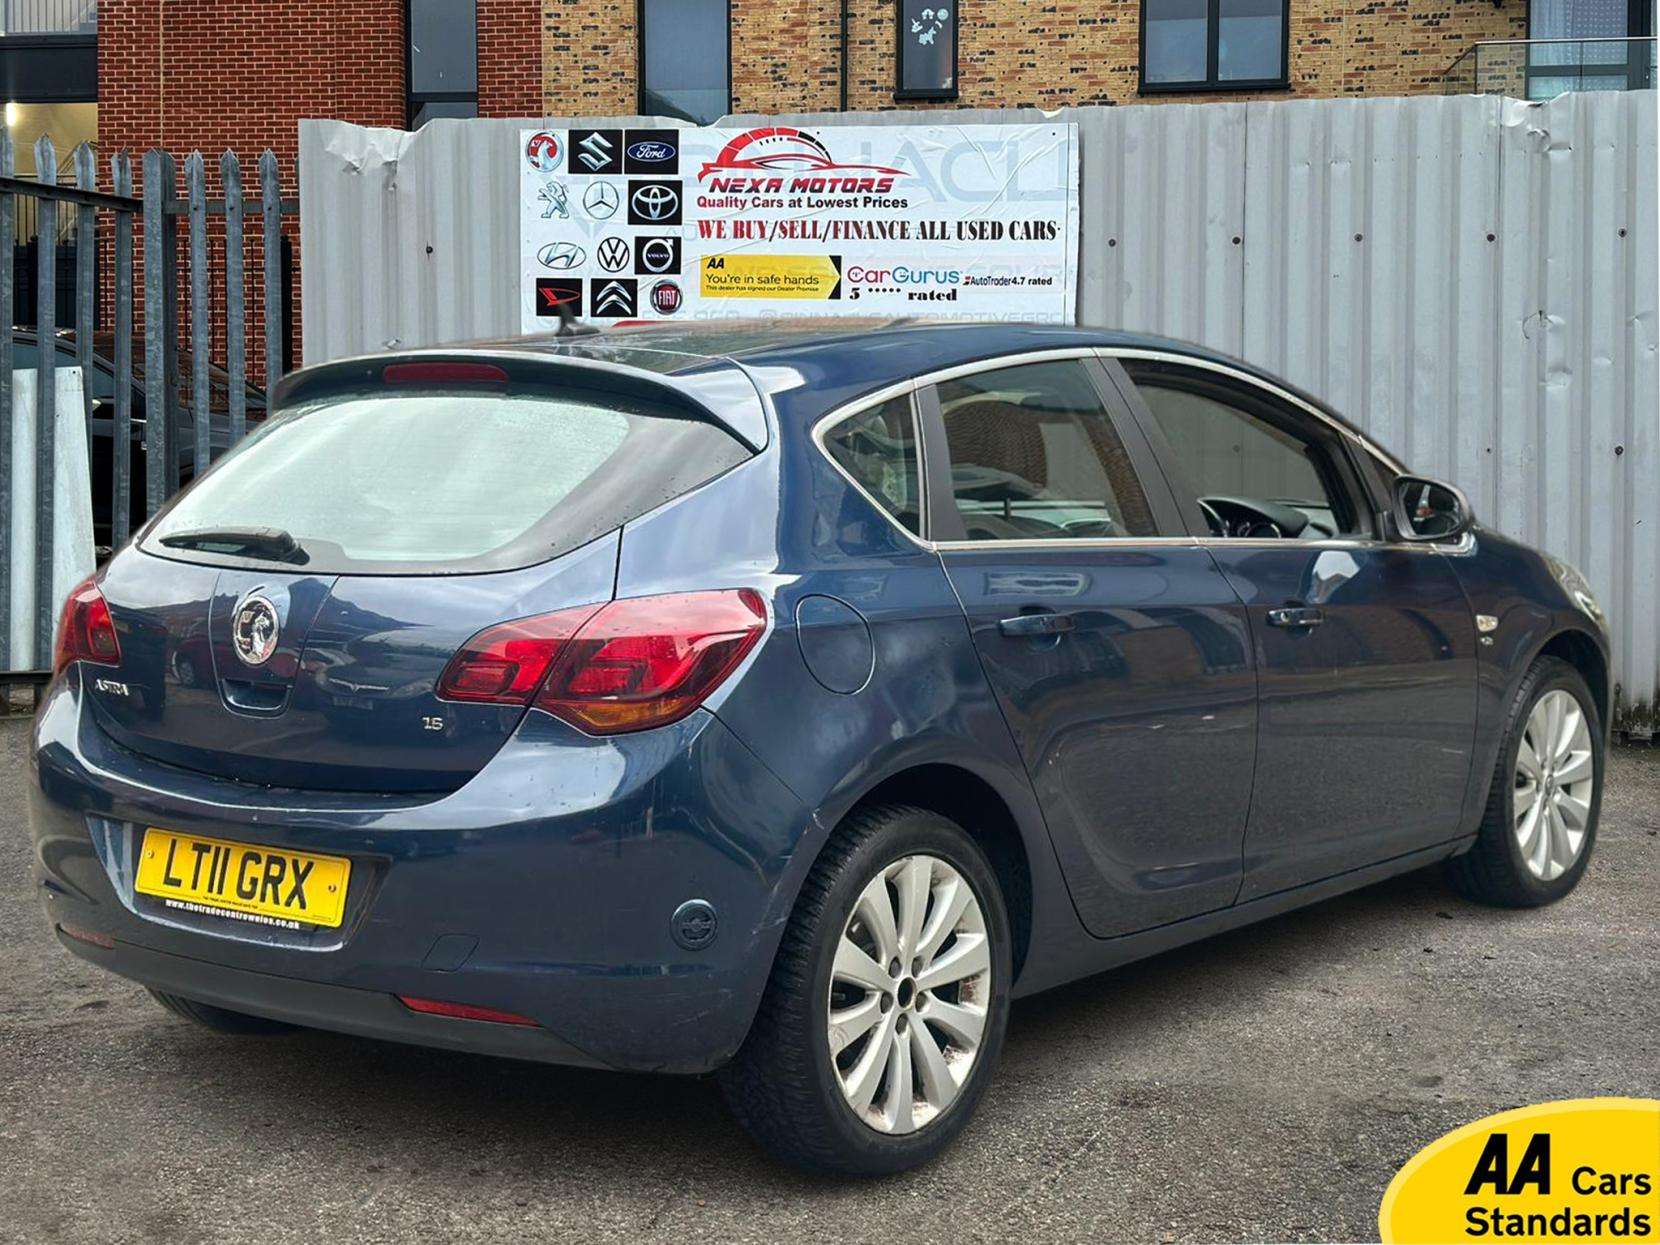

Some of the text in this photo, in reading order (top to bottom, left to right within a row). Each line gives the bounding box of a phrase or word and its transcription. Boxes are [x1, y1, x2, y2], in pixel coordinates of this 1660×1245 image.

[636, 145, 666, 159] Ford
[708, 177, 895, 194] NEXA MOTORS
[697, 196, 909, 210] Quality Cars at Lowest Prices
[697, 219, 727, 240] WE
[733, 219, 911, 243] BUY/SELL/FINANCE
[916, 220, 951, 241] ALL
[956, 220, 1004, 241] USED
[706, 257, 725, 269] AA
[705, 274, 820, 285] You're in safe hands
[847, 266, 960, 284] CarGurus
[1027, 276, 1053, 286] rated
[658, 289, 676, 305] FIAT
[849, 287, 958, 301] 5 rated
[236, 850, 314, 910] GRX
